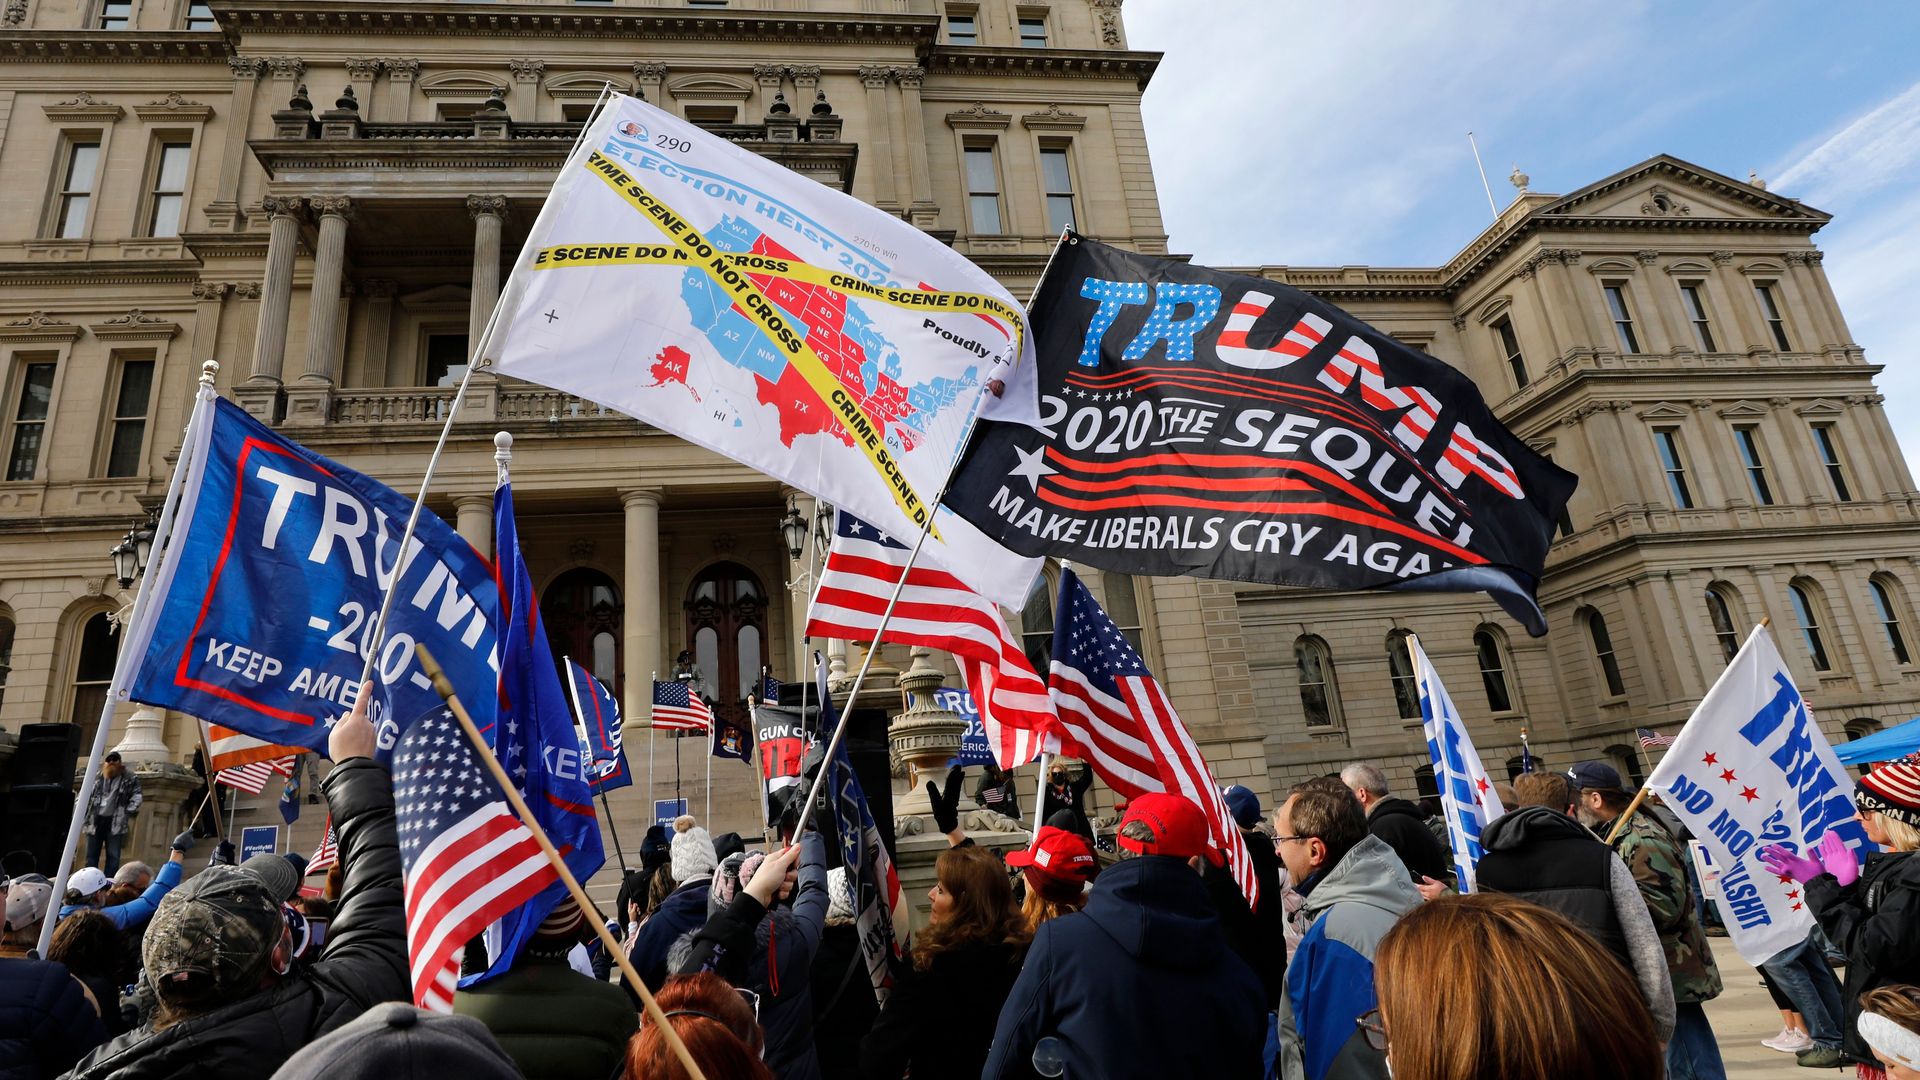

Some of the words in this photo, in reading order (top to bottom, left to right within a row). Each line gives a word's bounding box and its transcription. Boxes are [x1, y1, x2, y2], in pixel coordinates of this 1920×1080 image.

[656, 134, 691, 153] 290
[603, 142, 748, 206] ELECTION
[755, 199, 834, 251] HEIST
[732, 224, 748, 235] WA
[716, 240, 732, 251] OR
[854, 235, 870, 248] 270
[872, 244, 881, 253] to
[882, 249, 898, 261] win
[552, 246, 630, 262] SCENE
[635, 247, 667, 259] DO
[830, 274, 884, 298] CRIME
[888, 291, 950, 307] SCENE
[953, 296, 979, 307] DO
[688, 277, 702, 288] CA
[779, 289, 795, 303] WY
[825, 287, 838, 301] ND
[820, 306, 832, 319] SD
[847, 313, 861, 327] MN
[588, 152, 631, 187] RIME
[627, 186, 687, 235] SCENE
[683, 232, 712, 258] DO
[710, 258, 750, 293] NOT
[746, 293, 802, 354] CROSS
[831, 389, 879, 450] CRIME
[876, 449, 917, 509] SCENE
[723, 329, 741, 342] AZ
[816, 326, 829, 338] NE
[867, 339, 877, 351] WI
[922, 318, 990, 359] Proudly
[756, 348, 775, 363] NM
[816, 350, 830, 361] KS
[848, 344, 857, 356] IA
[665, 360, 681, 375] AK
[887, 366, 897, 377] MI
[846, 370, 860, 384] MO
[866, 371, 874, 381] IL
[878, 381, 887, 392] IN
[893, 387, 904, 398] OH
[928, 385, 941, 397] NY
[1078, 276, 1525, 500] TRUMP
[793, 399, 809, 414] TX
[883, 401, 893, 413] KY
[914, 394, 925, 406] PA
[713, 410, 726, 422] HI
[874, 405, 886, 419] TN
[834, 423, 847, 436] LA
[912, 417, 923, 430] VA
[1041, 395, 1154, 454] 2020
[1158, 407, 1219, 437] THE
[887, 436, 899, 449] GA
[906, 429, 917, 442] NC
[988, 484, 1087, 543] MAKE
[1083, 515, 1226, 550] LIBERALS
[1229, 518, 1322, 557] CRY
[256, 464, 500, 672] TRUM
[204, 638, 283, 683] KEEP
[759, 724, 789, 741] GUN
[1856, 791, 1904, 821] AGAIN
[1668, 774, 1714, 815] NO
[1708, 808, 1757, 861] MO
